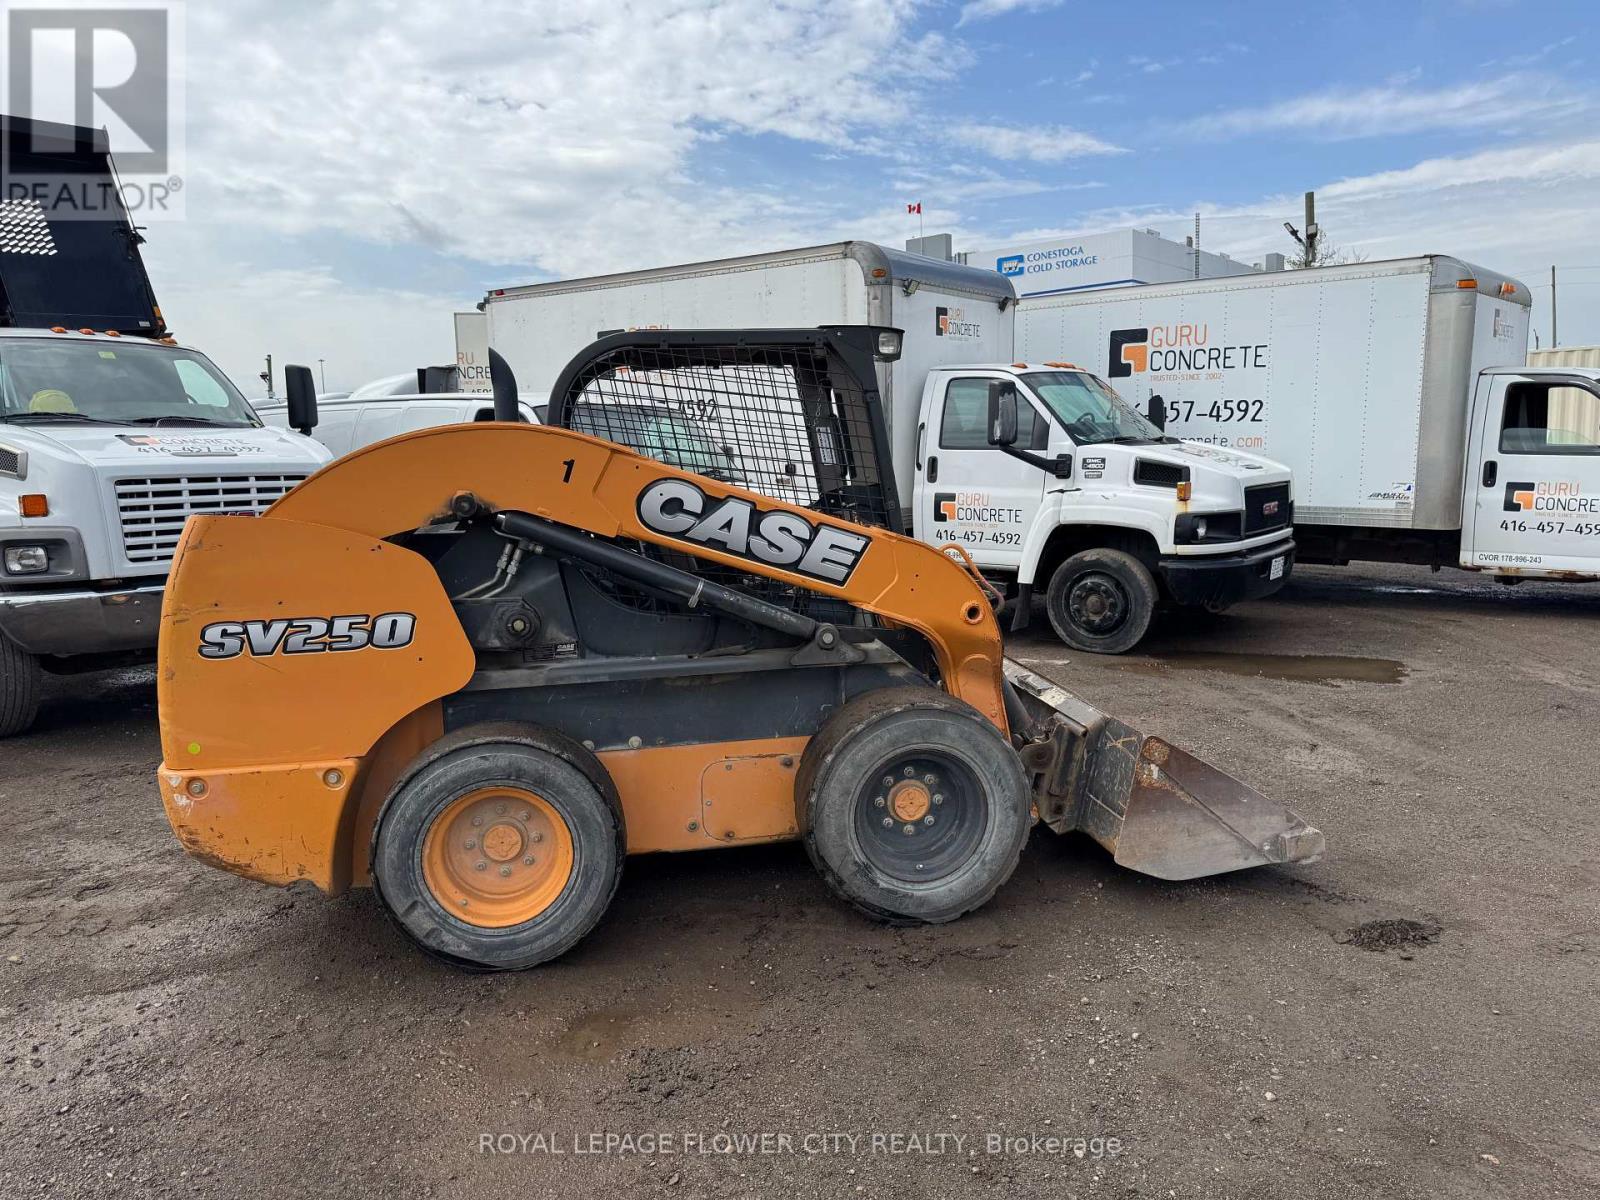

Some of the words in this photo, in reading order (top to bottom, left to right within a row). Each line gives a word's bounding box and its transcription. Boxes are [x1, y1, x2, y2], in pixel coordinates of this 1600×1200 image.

[1027, 246, 1084, 262] CONESTOGA
[1027, 264, 1052, 274] COLD
[1055, 256, 1098, 270] STORAGE
[1151, 324, 1207, 348] GURU
[1150, 345, 1268, 371] CONCRETE
[562, 458, 575, 483] 1
[1537, 482, 1580, 497] GURU
[957, 493, 989, 507] GURU
[957, 508, 1022, 523] CONCRETE
[638, 479, 870, 584] CASE
[936, 529, 1021, 545] 416-457-4592
[1479, 554, 1499, 562] CVOR
[199, 613, 416, 659] SV250
